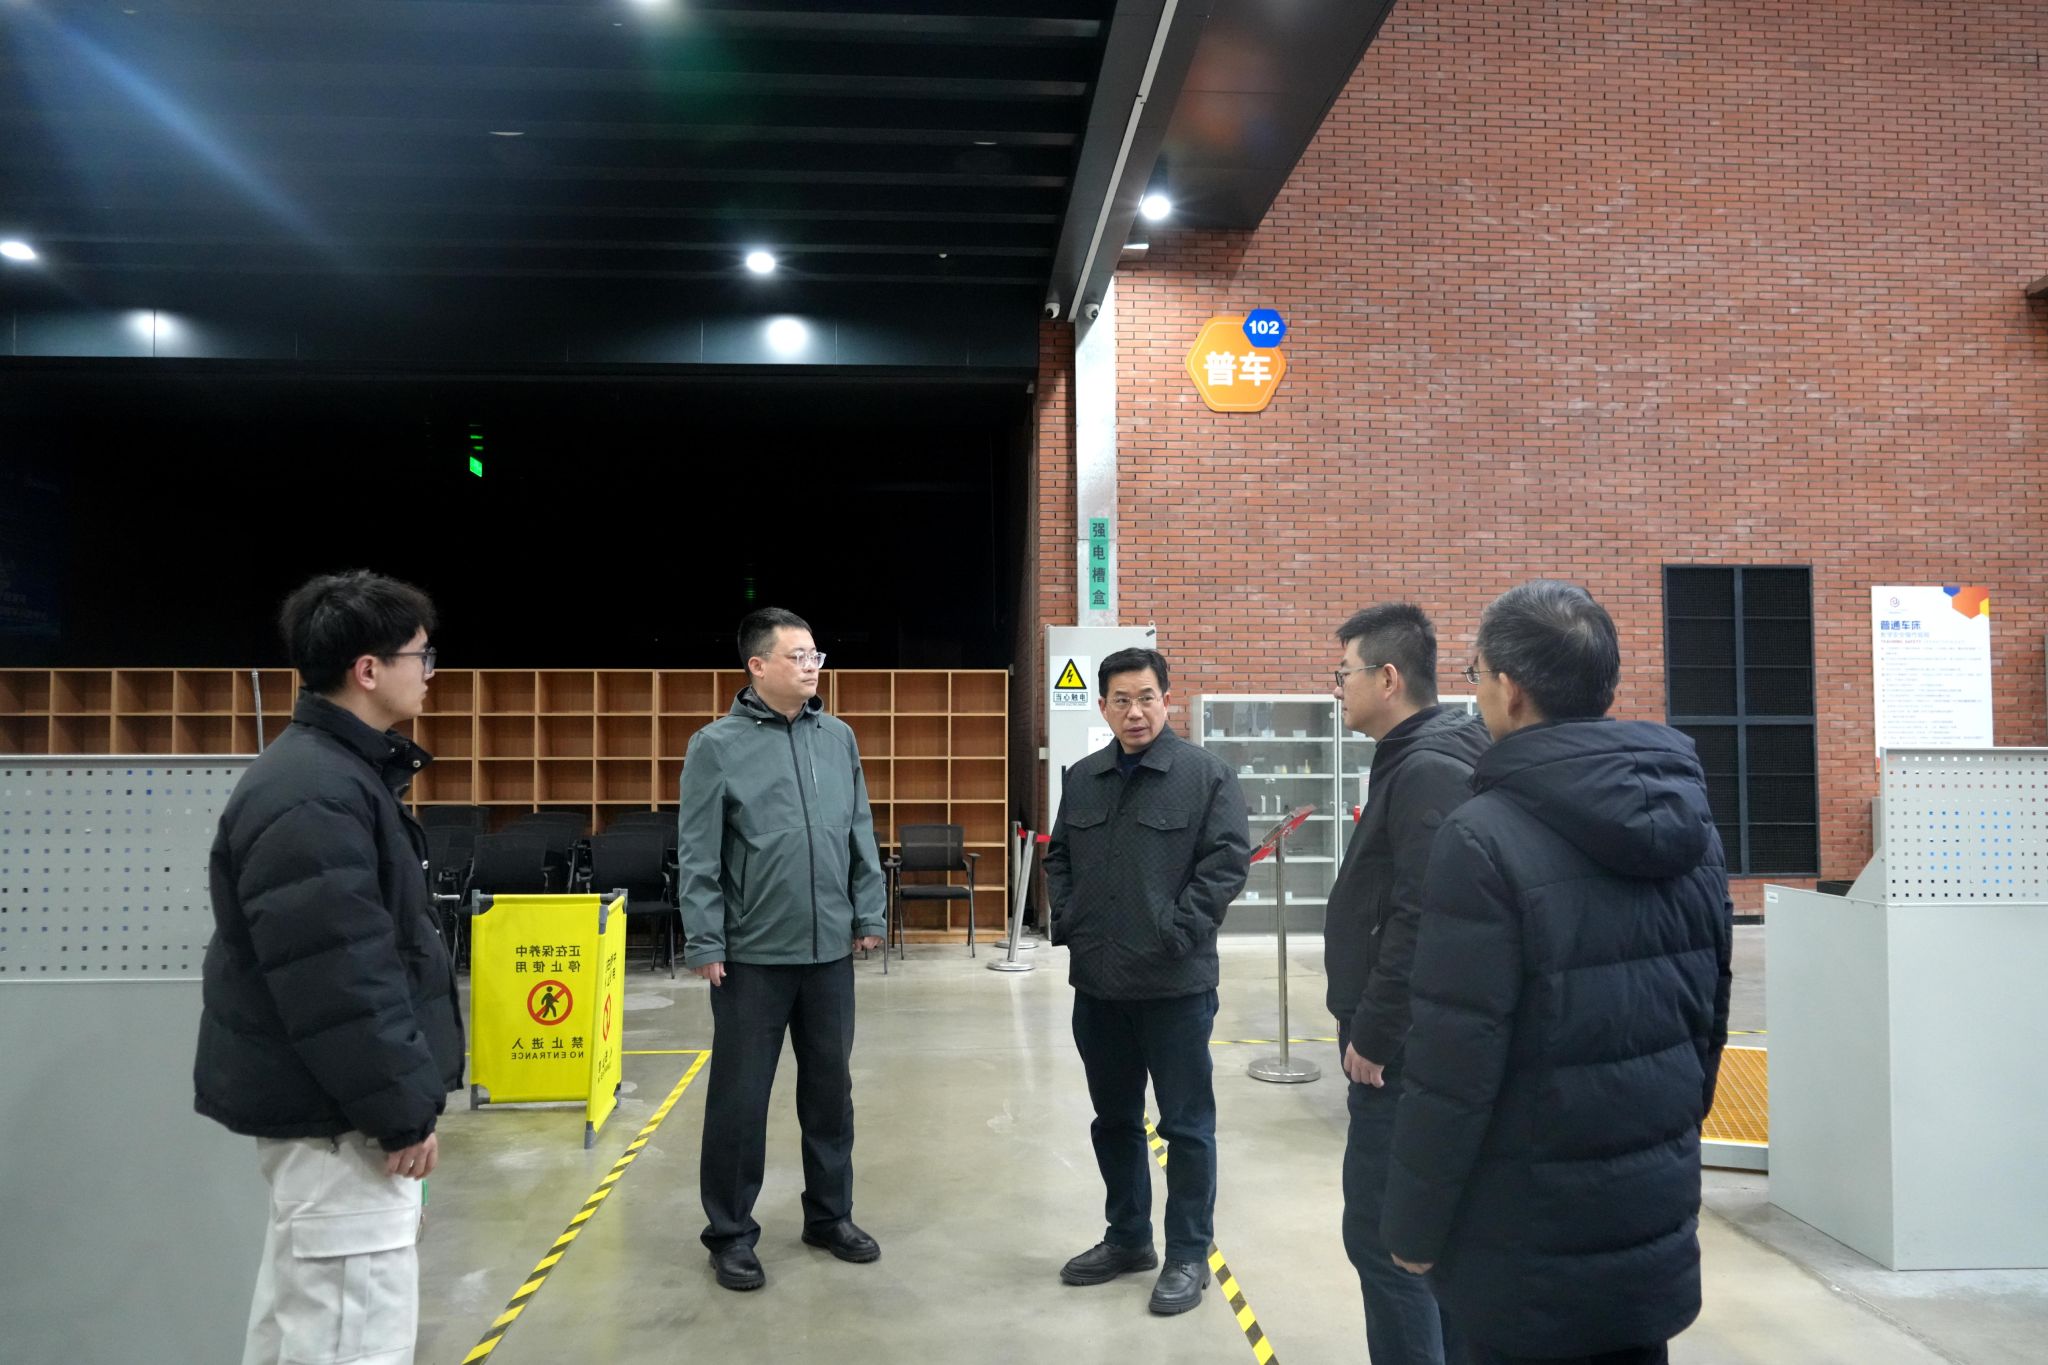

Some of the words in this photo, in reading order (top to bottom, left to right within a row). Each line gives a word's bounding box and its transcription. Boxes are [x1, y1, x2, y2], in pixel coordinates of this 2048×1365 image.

[1249, 320, 1280, 335] 102
[1203, 351, 1272, 387] 普车
[1092, 522, 1106, 606] 强电槽盒
[1880, 620, 1921, 631] 普通车床
[1055, 693, 1086, 702] 当心触电
